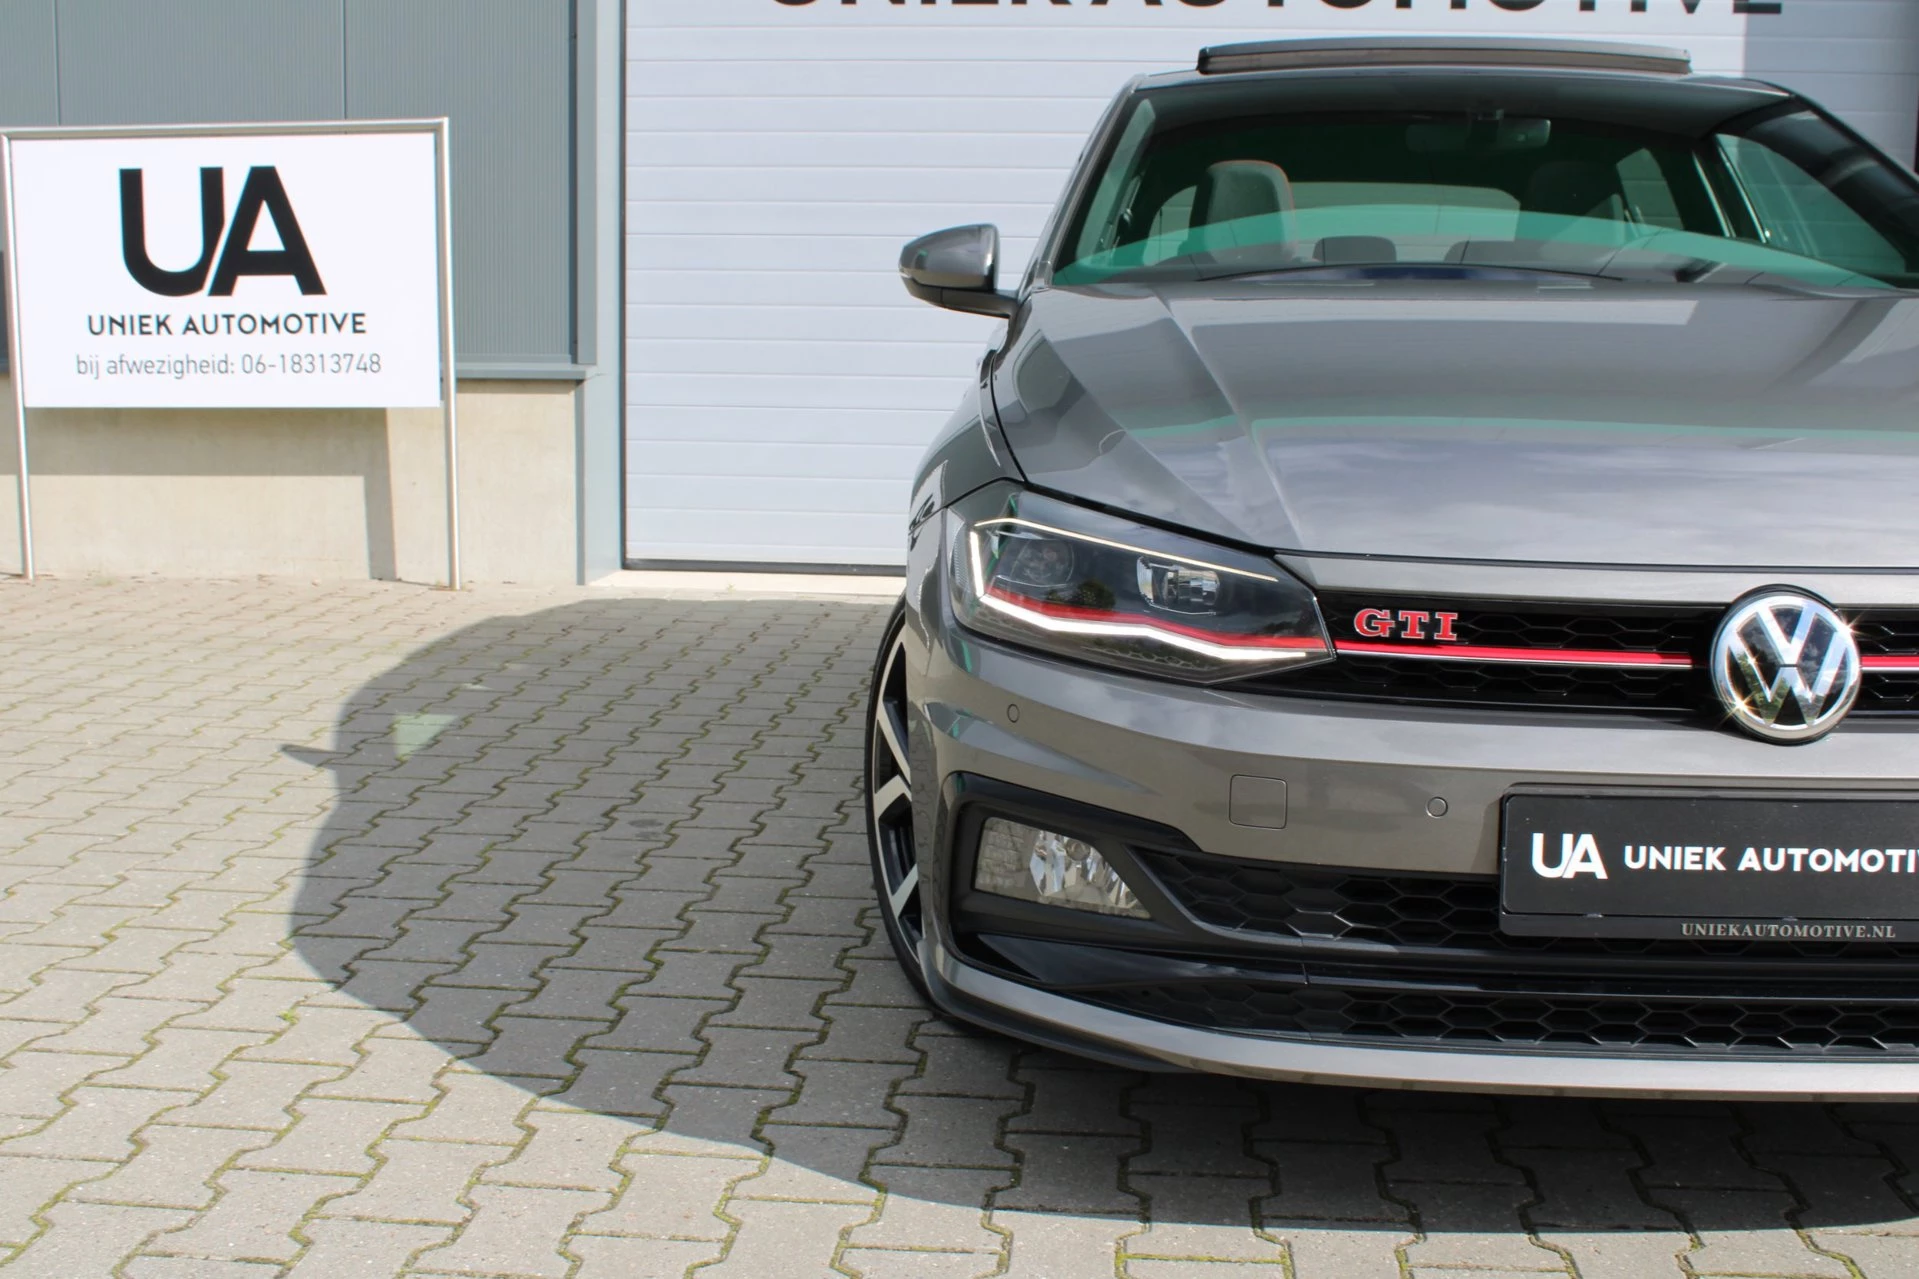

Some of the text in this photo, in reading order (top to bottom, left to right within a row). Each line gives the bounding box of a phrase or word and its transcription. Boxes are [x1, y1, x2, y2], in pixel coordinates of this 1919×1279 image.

[119, 166, 327, 297] UA
[88, 312, 366, 336] UNIEK AUTOMOTIVE
[76, 353, 382, 380] bij afwezigheid: 06-18313748
[1354, 608, 1458, 641] GTI
[1531, 832, 1919, 880] UA UNIEK AUTOMOTI
[1681, 922, 1897, 939] UNIEKAUTOMOTIVE.NL
